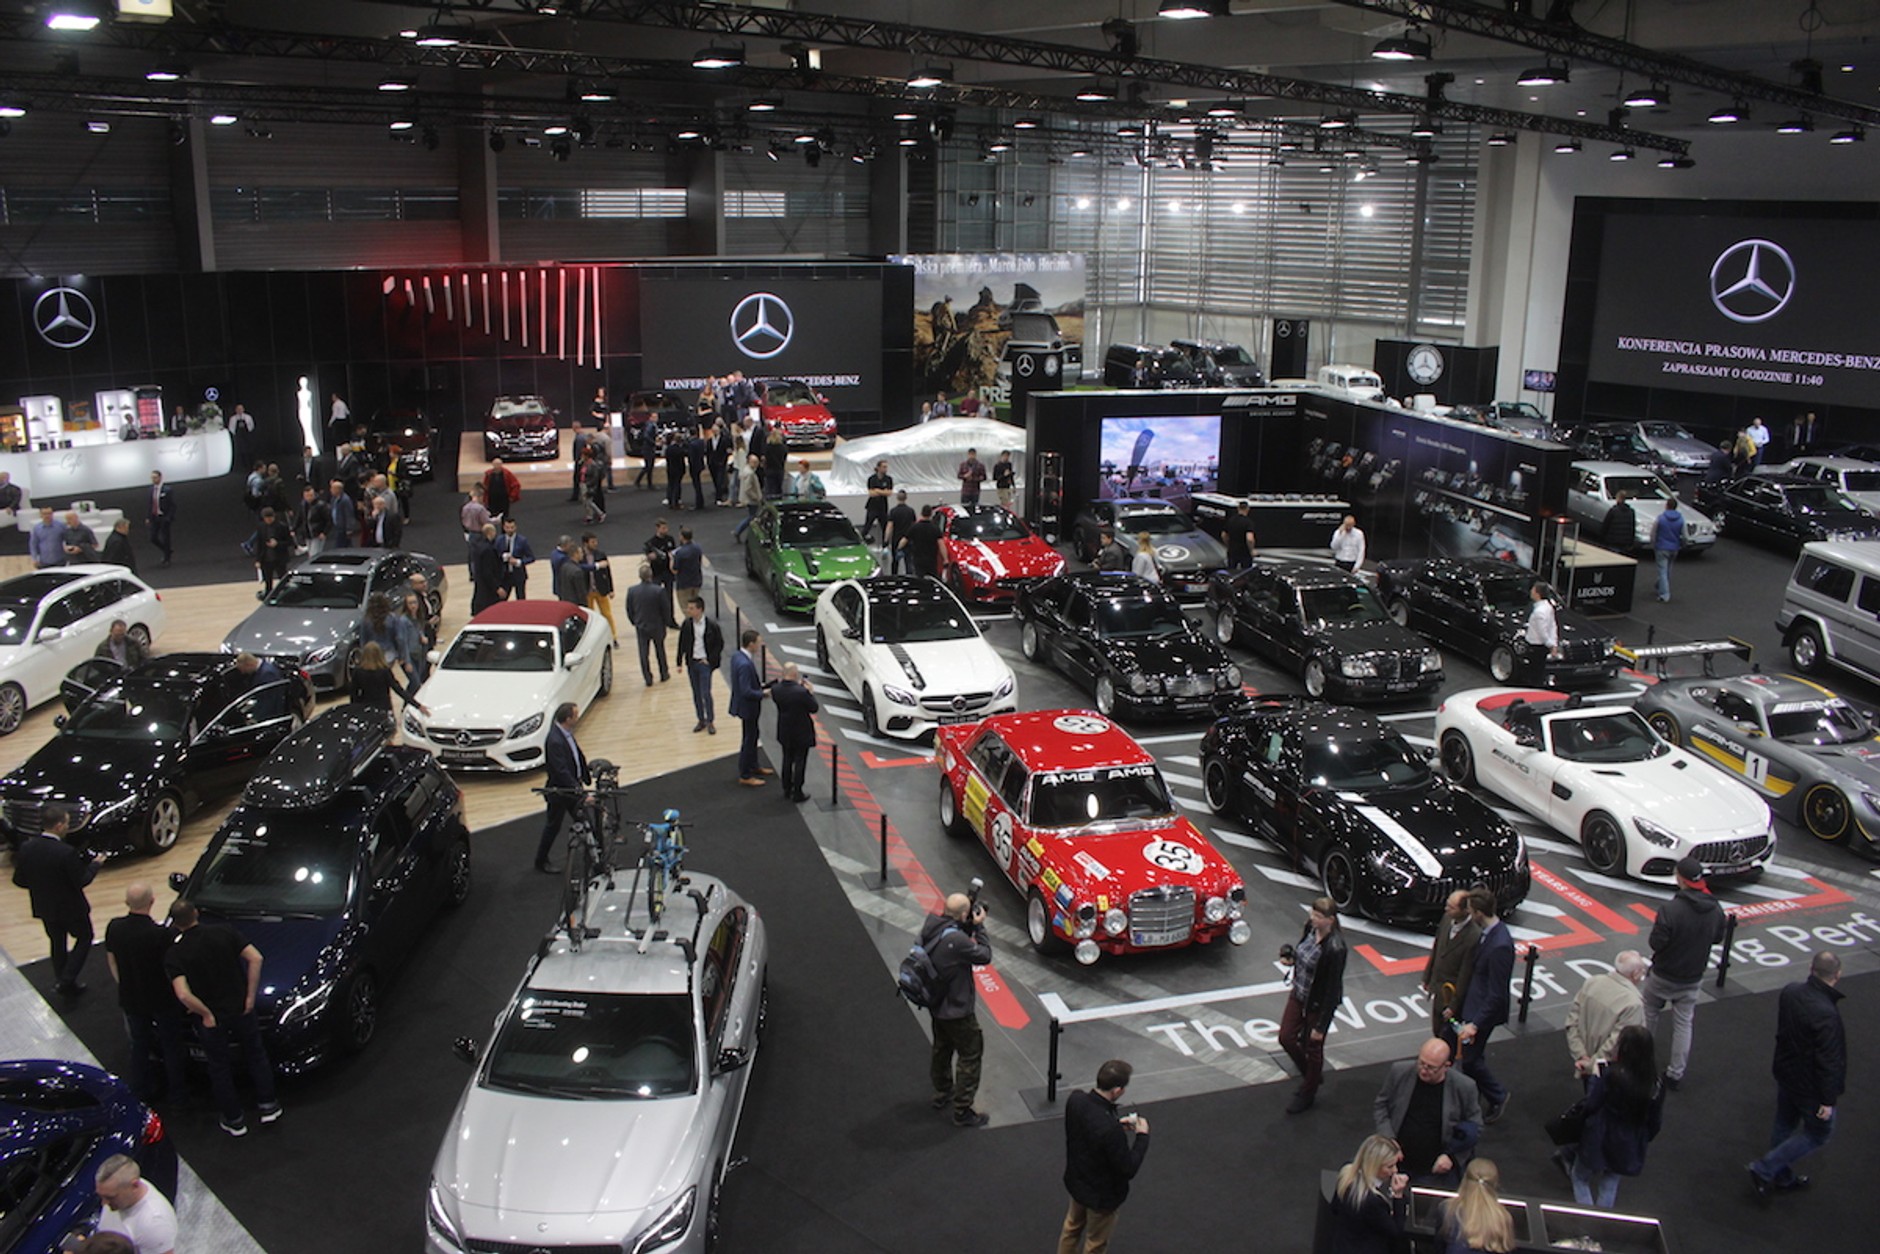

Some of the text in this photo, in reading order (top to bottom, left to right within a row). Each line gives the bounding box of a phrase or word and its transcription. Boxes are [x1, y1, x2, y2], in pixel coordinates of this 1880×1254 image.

[911, 258, 938, 274] olska
[990, 257, 1015, 273] Marco
[1017, 257, 1036, 272] Polo
[1617, 336, 1880, 370] KONFERENCJA PRASOWA MERCEDES-BENZ
[1662, 361, 1824, 386] ZAPRASZAMY O GODZINIE 11:40
[1246, 395, 1297, 405] AMG
[1577, 587, 1616, 598] LEGENDS
[1798, 697, 1848, 711] AMG
[1706, 731, 1746, 756] AMG
[1041, 766, 1155, 787] AMG AMG
[1753, 757, 1760, 780] 1
[993, 819, 1012, 862] 35
[1154, 843, 1192, 871] 35
[1534, 870, 1593, 907] YEARS AMG
[1724, 900, 1803, 917] EMIERA
[1146, 965, 1568, 1056] The Wor of
